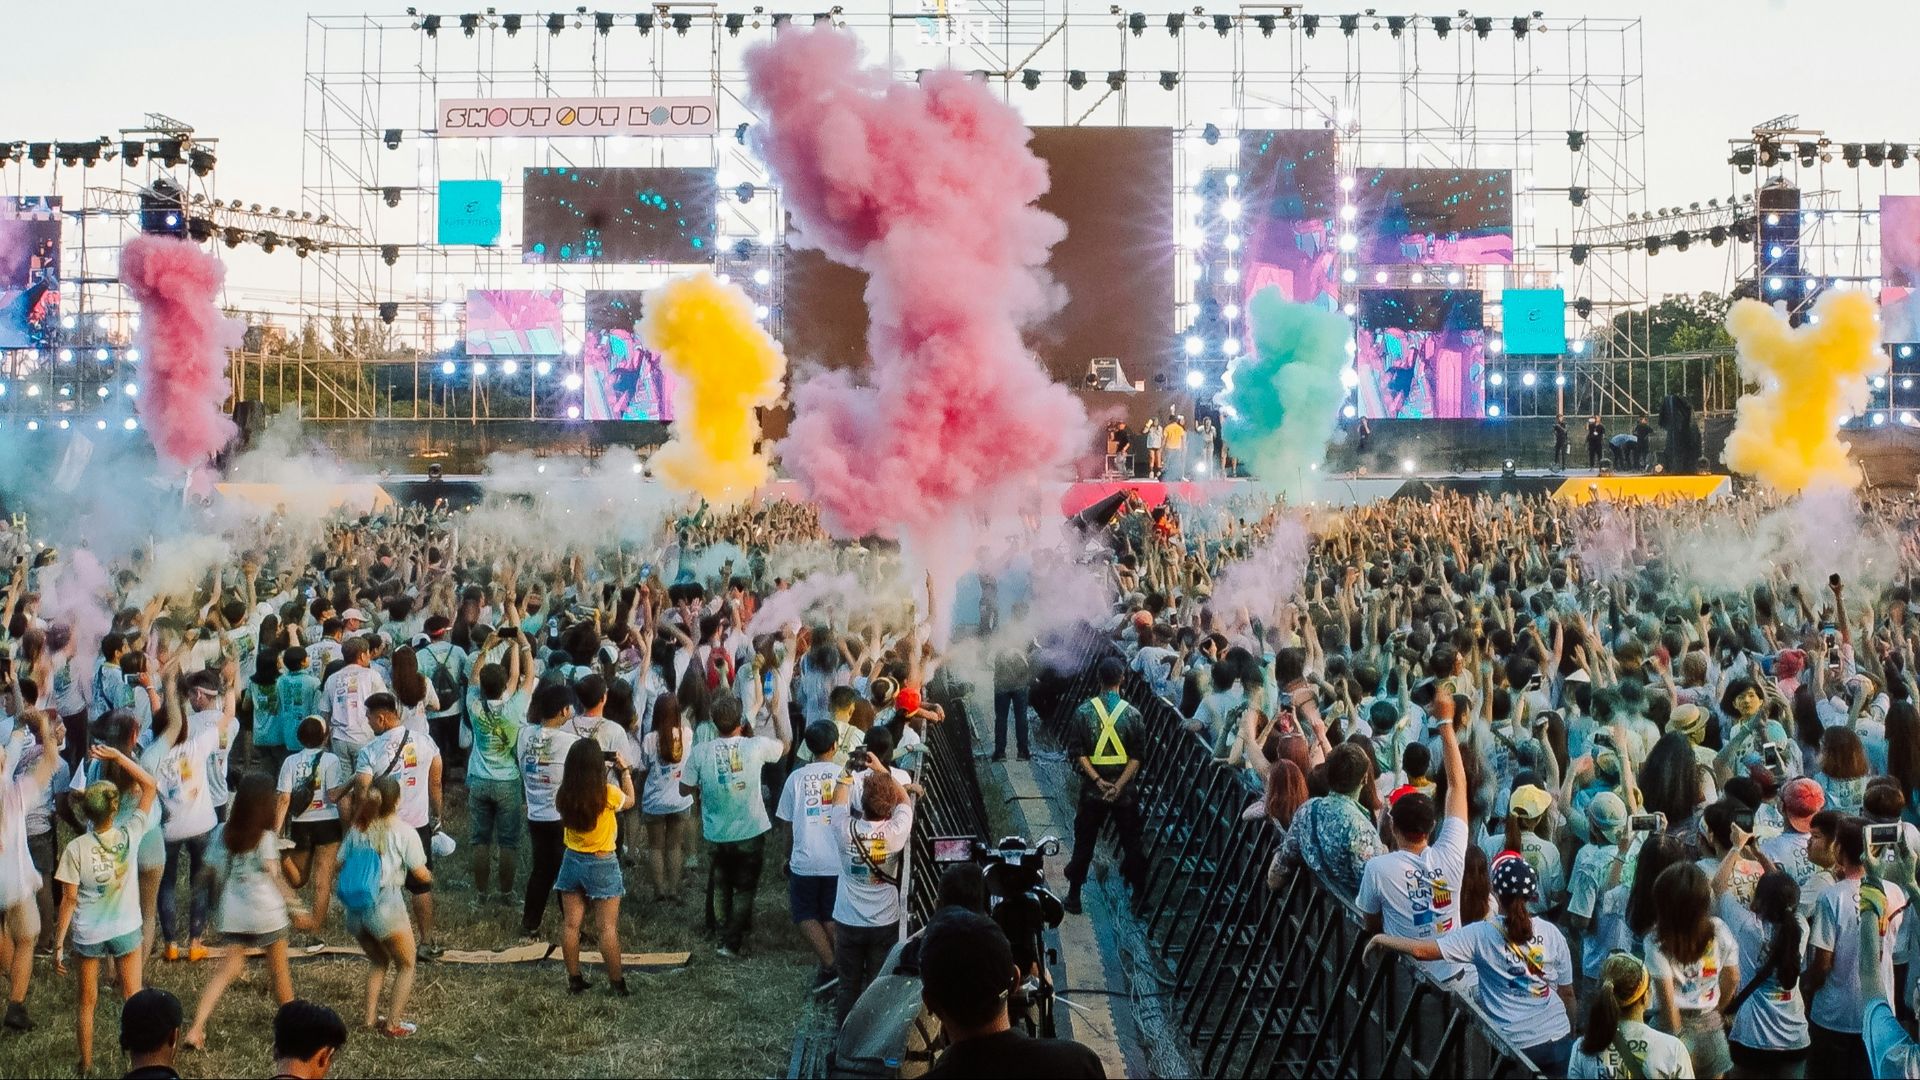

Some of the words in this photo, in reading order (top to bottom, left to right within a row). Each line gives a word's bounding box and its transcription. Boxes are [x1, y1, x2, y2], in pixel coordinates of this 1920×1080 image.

[446, 107, 550, 128] SHOUT
[556, 106, 620, 127] OUT
[628, 105, 711, 127] LOUD
[803, 772, 833, 781] COLOR
[804, 789, 822, 798] RUN
[1521, 843, 1542, 852] LOR
[92, 860, 114, 873] RUN
[1405, 867, 1444, 880] COLOR
[1408, 888, 1433, 901] RUN
